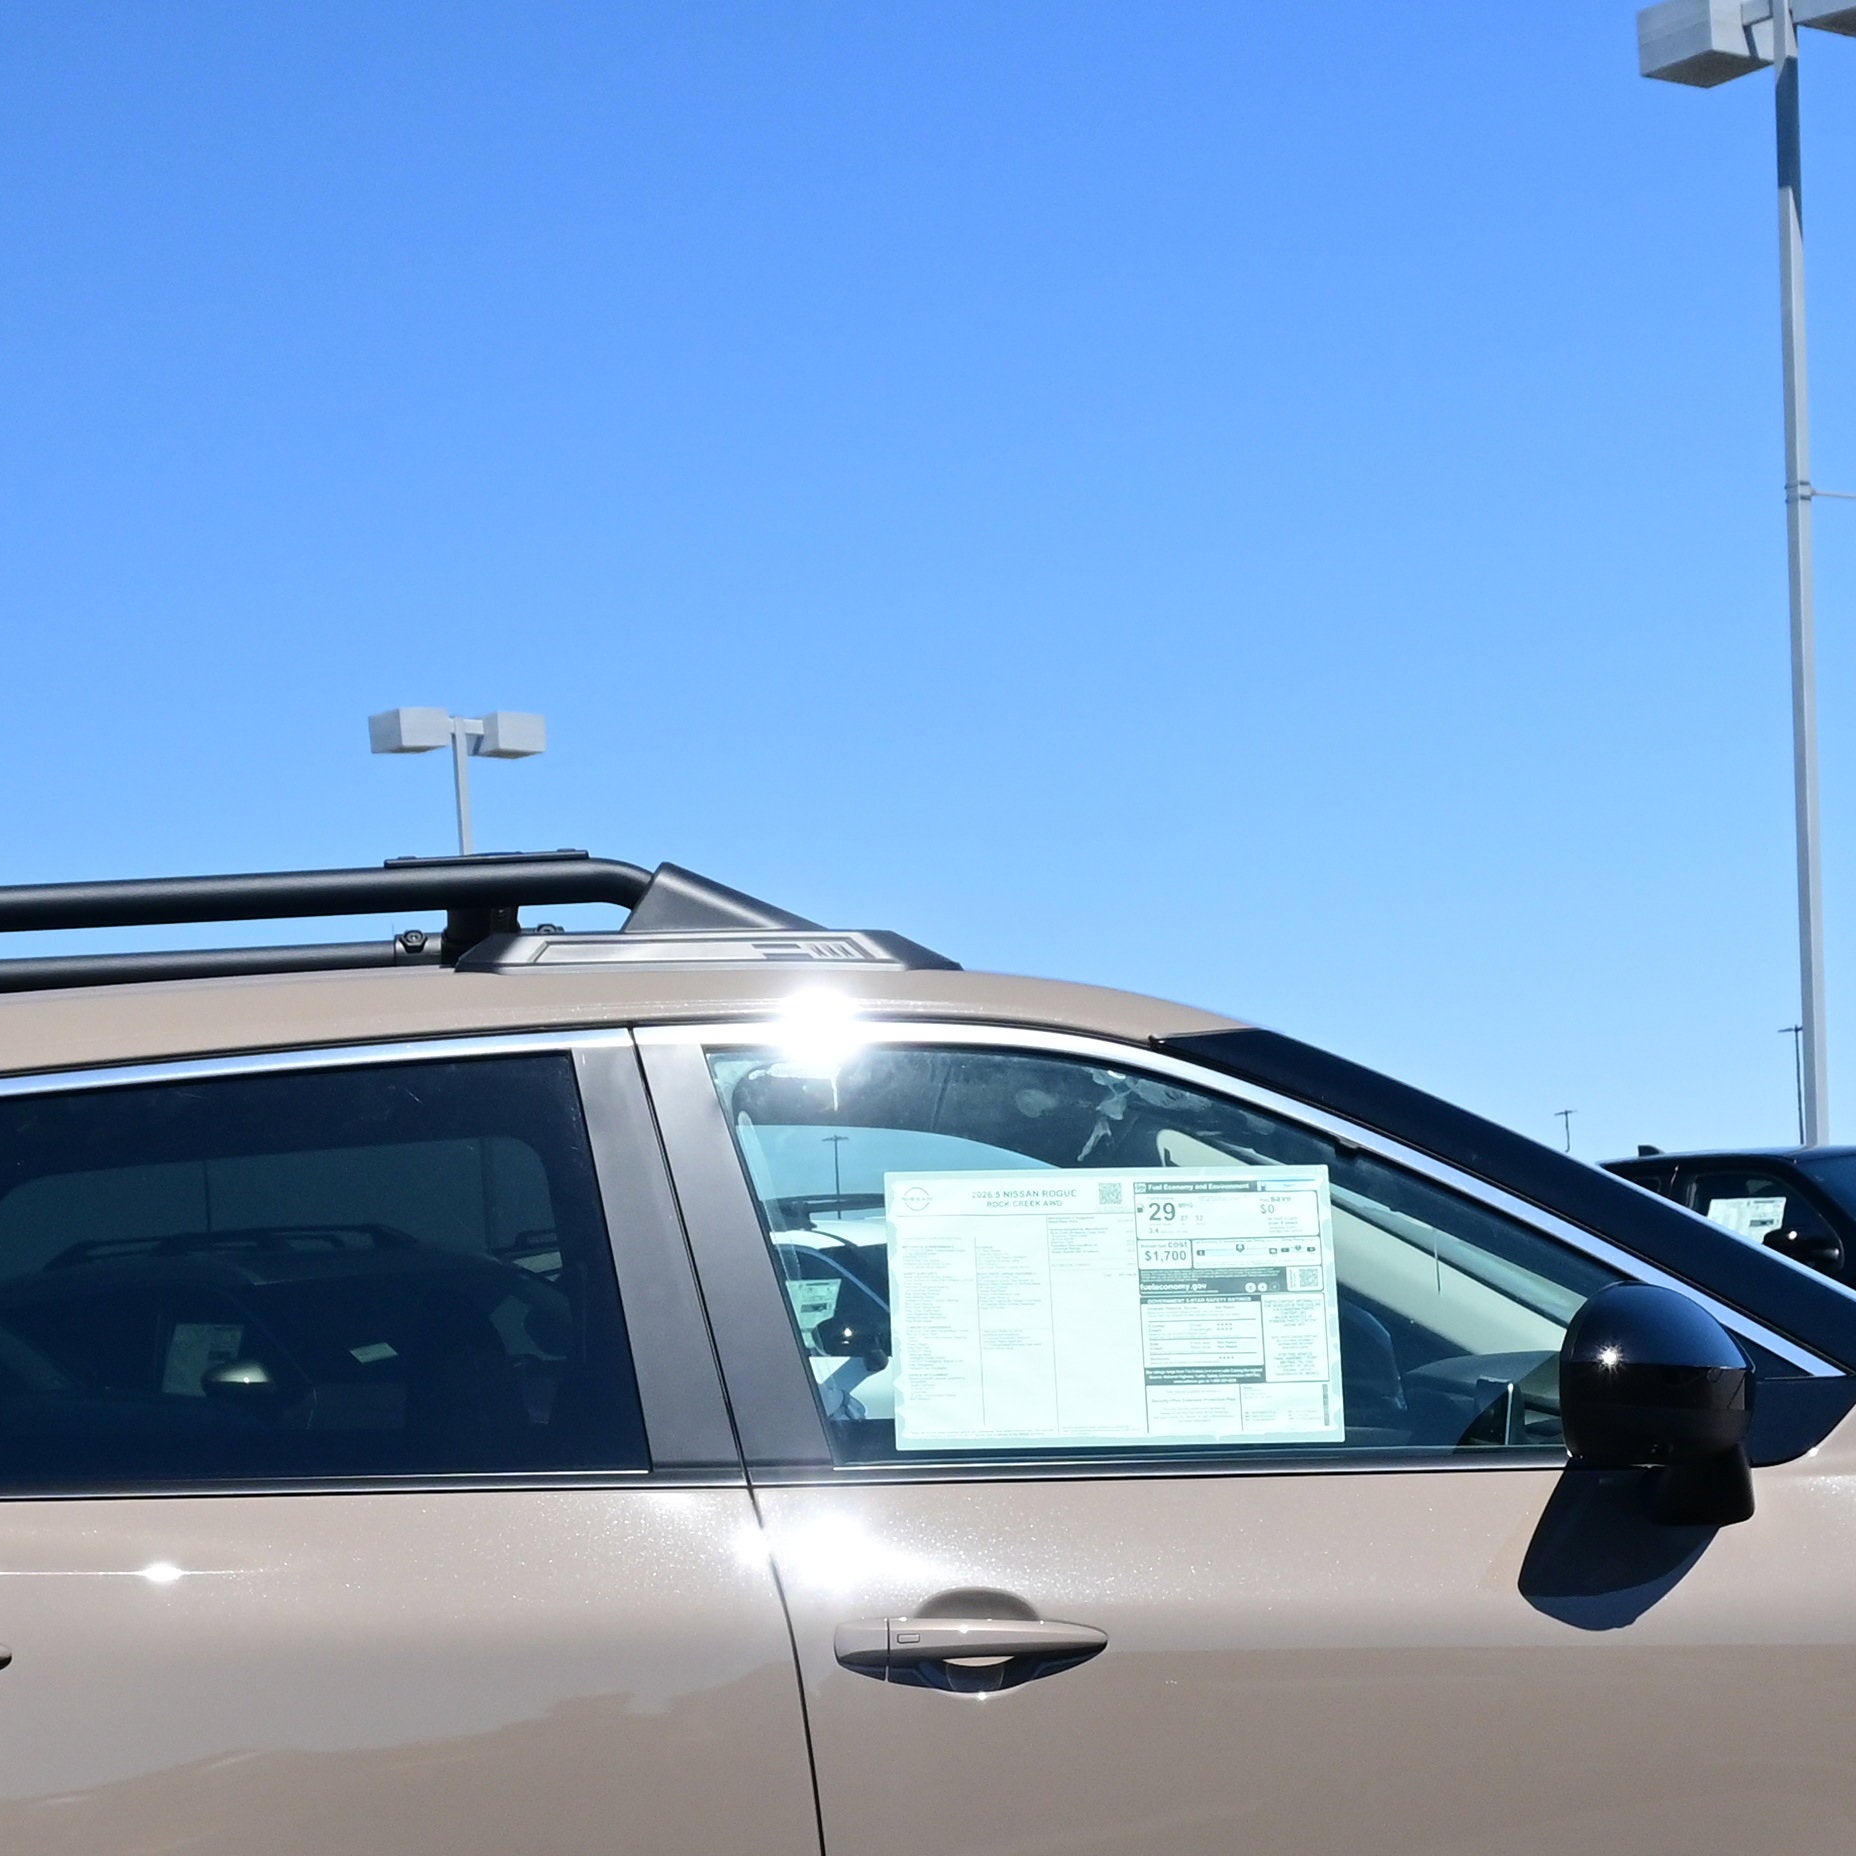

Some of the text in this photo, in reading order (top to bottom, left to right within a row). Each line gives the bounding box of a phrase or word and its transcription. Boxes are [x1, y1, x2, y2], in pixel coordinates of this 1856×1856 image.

[1003, 1190, 1039, 1198] NISSAN
[1042, 1189, 1077, 1198] ROGUE
[1149, 1202, 1176, 1221] 29
[1260, 1204, 1274, 1214] $0
[1145, 1250, 1186, 1262] $1,700
